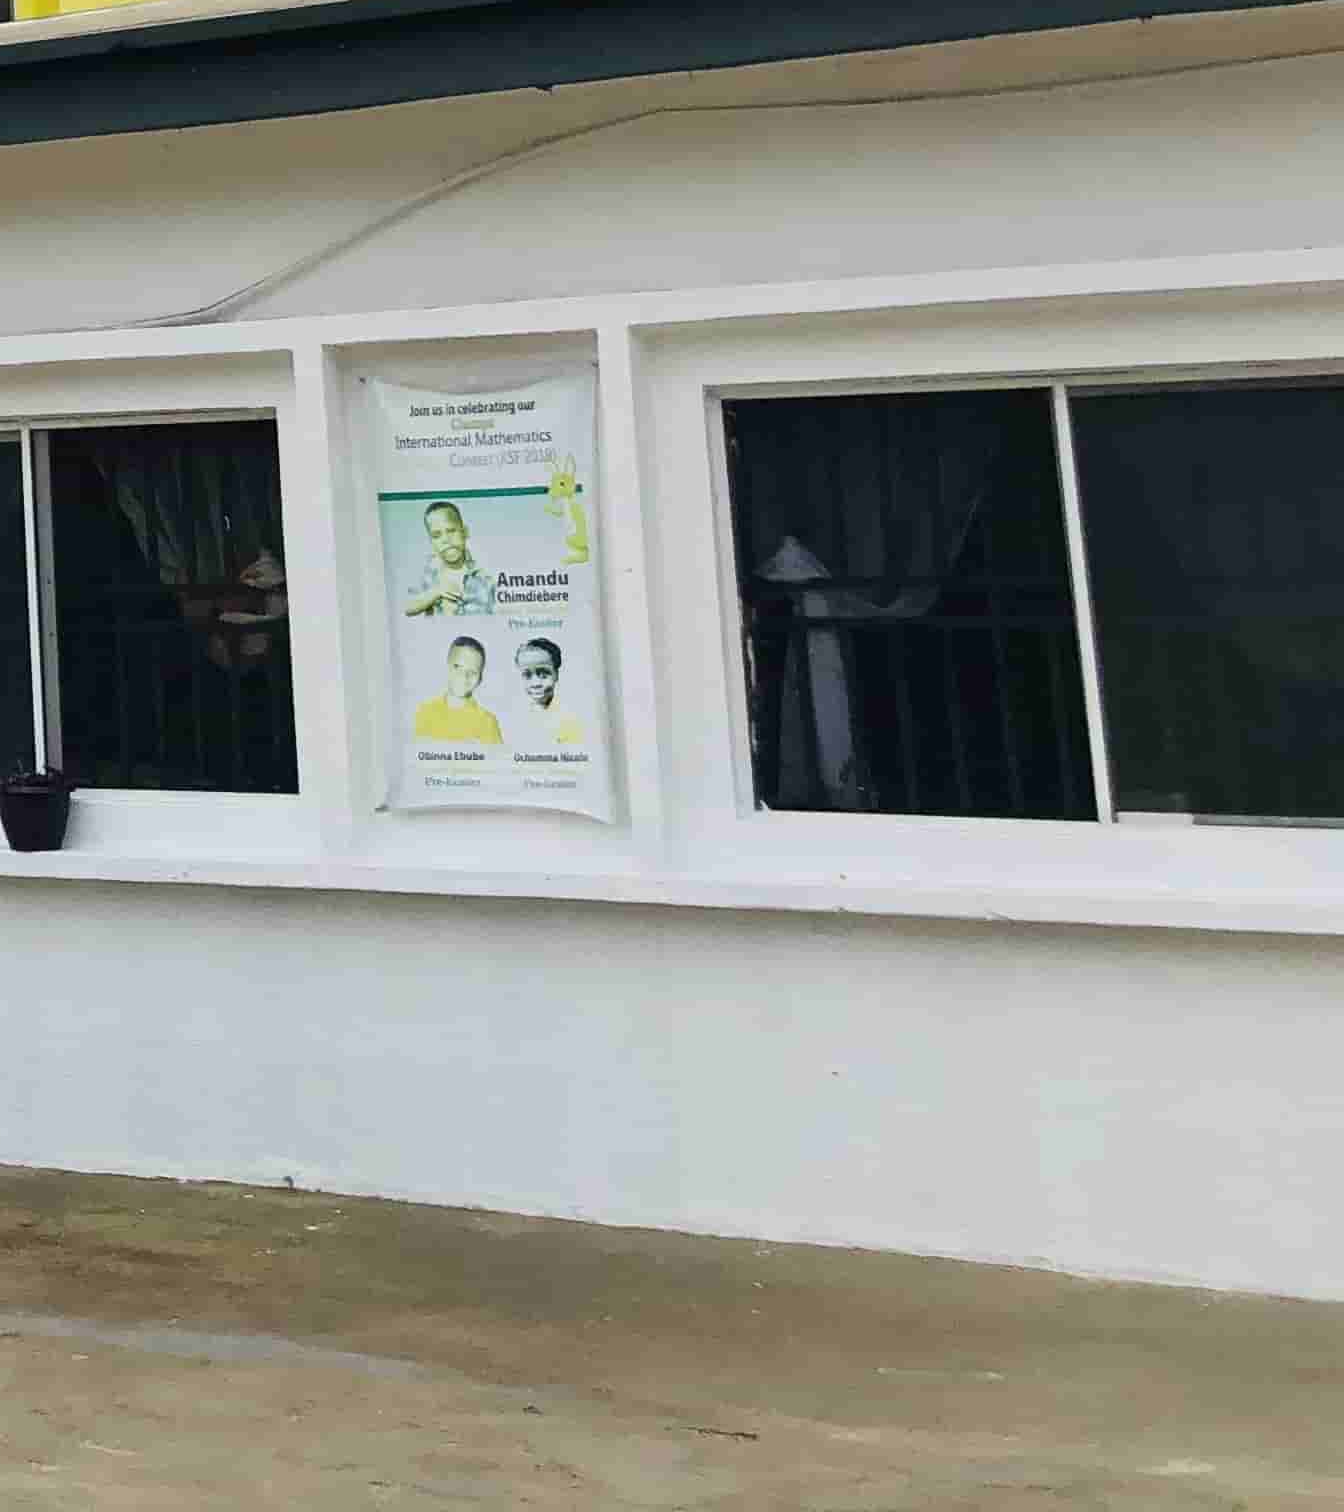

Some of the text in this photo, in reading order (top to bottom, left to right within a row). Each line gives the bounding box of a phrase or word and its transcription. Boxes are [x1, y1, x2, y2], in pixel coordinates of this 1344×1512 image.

[408, 400, 536, 417] Join us in celebrating our
[395, 431, 553, 450] International Mathematics
[496, 569, 569, 587] Amandu
